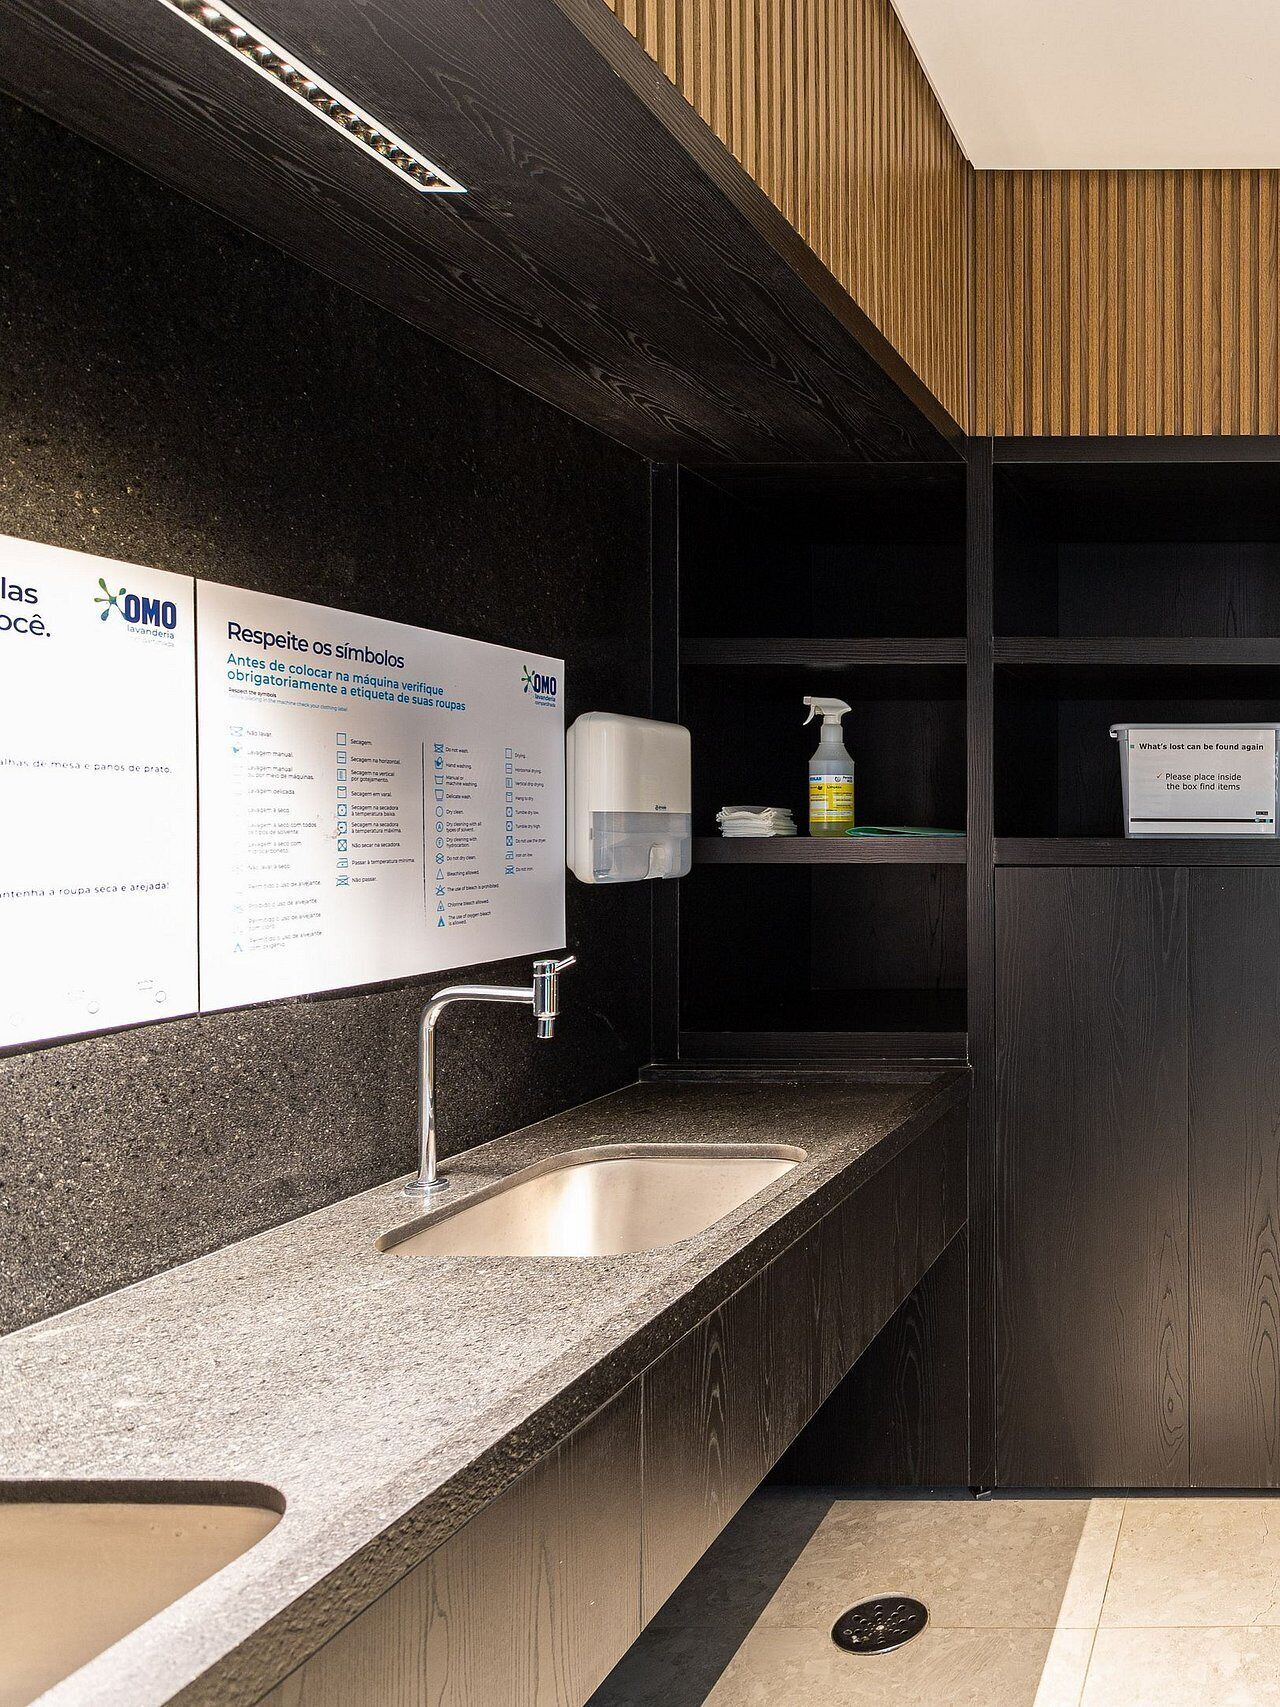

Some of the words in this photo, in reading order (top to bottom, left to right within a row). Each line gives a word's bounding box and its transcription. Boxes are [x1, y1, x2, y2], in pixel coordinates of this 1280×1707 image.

[1, 577, 38, 604] las
[125, 594, 177, 629] OMO
[127, 625, 174, 639] lavanderia
[228, 621, 308, 652] Respeite
[313, 640, 331, 656] os
[336, 643, 405, 668] símbolos
[227, 654, 265, 669] Antes
[269, 660, 285, 672] de
[289, 663, 332, 679] colocar
[336, 671, 349, 682] na
[353, 673, 399, 690] máquina
[401, 681, 444, 697] verifique
[533, 674, 557, 695] OMO
[227, 669, 337, 694] obrigatoriamente
[341, 686, 347, 695] a
[350, 687, 394, 703] etiqueta
[397, 692, 409, 703] de
[412, 695, 433, 706] suas
[436, 699, 465, 711] roupas
[535, 694, 555, 702] lavanderia
[1194, 774, 1215, 782] place
[60, 886, 90, 896] roupa
[94, 885, 118, 893] seca
